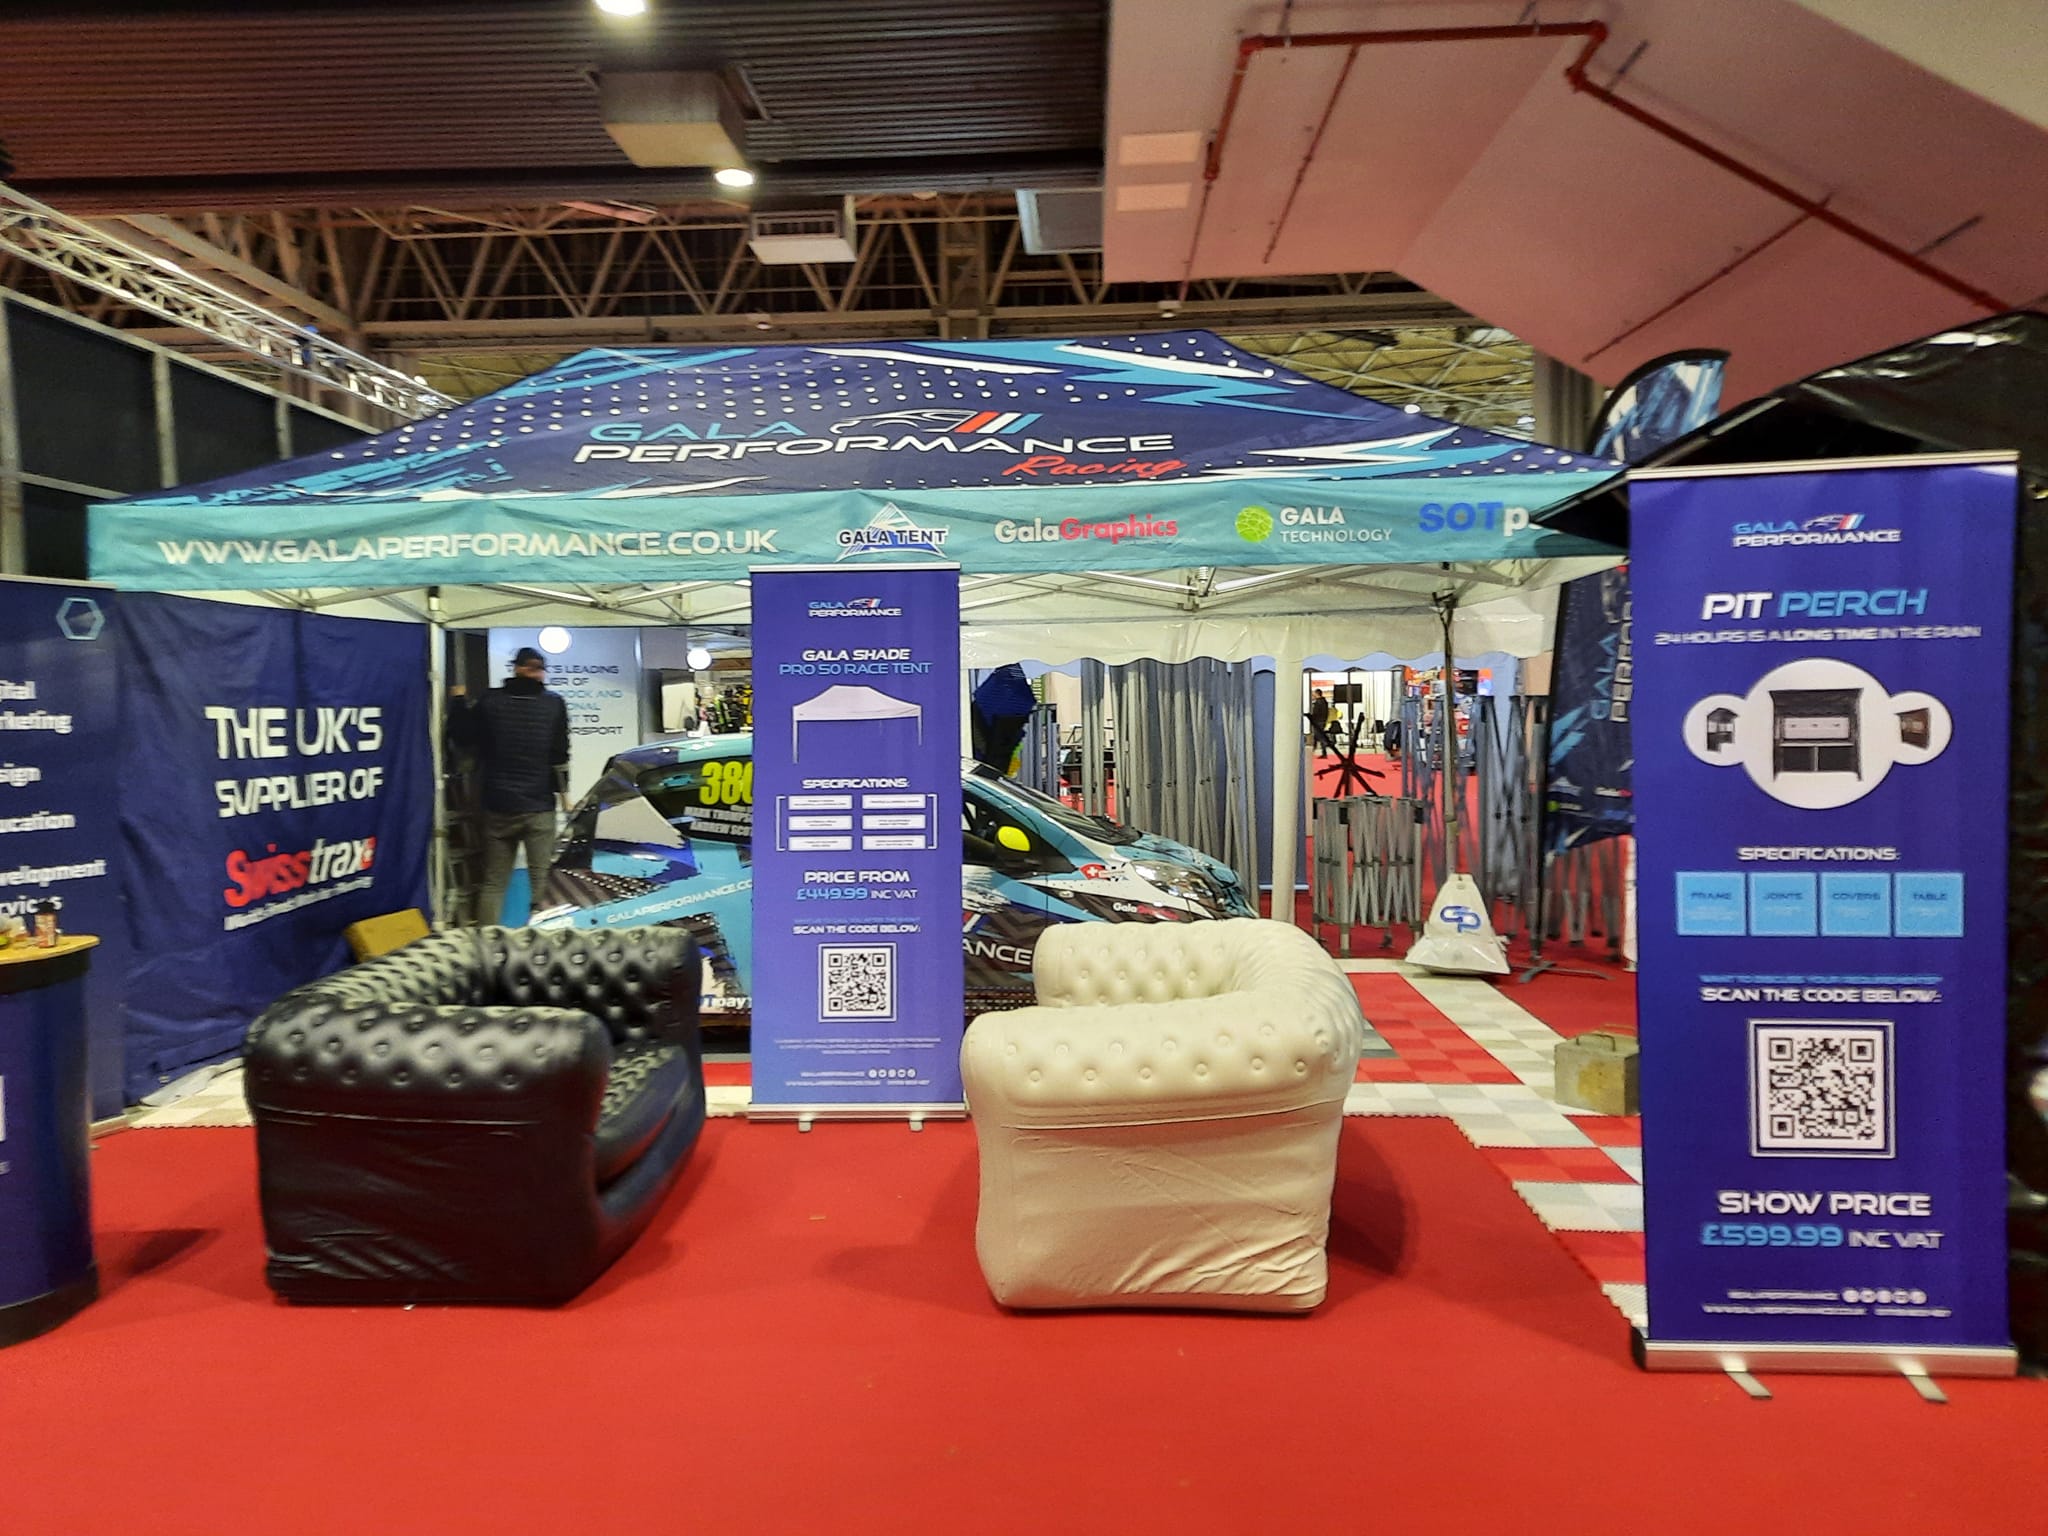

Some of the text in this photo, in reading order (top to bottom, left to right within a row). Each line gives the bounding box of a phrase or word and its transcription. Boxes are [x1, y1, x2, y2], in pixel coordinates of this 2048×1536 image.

[590, 421, 807, 442] GALA
[573, 434, 1175, 464] PERFORMANCE
[1001, 456, 1188, 478] Racing
[1280, 506, 1345, 526] GALA
[1418, 502, 1530, 537] SOTp
[995, 514, 1178, 545] GalaGraphics
[1280, 527, 1393, 545] TECHNOLOGY
[1733, 521, 1798, 533] GALA
[839, 528, 947, 546] GALA TENT
[1733, 529, 1902, 548] PERFORMANCE
[157, 528, 779, 565] WWW.GALAPERFORMANCE.CO.UK
[808, 601, 846, 609] GALA
[808, 608, 903, 618] PERFORMANCE
[1701, 588, 1929, 620] PIT PERCH
[802, 648, 911, 662] GALA SHADE
[566, 664, 620, 674] LEADING
[779, 663, 816, 676] PRO
[845, 663, 888, 675] RACE
[890, 662, 933, 674] TENT
[0, 680, 37, 700] ital
[573, 677, 590, 686] OF
[582, 714, 600, 723] TO
[205, 706, 383, 760] THE UK'S
[216, 766, 384, 818] SUPPLIER OF
[730, 825, 753, 837] SCO
[804, 870, 911, 884] PRICE FROM
[796, 887, 918, 900] £449.99 INC VAT
[0, 895, 63, 916] rvics
[793, 925, 825, 935] SCAN
[827, 925, 847, 934] THE
[848, 924, 878, 934] CODE
[1701, 987, 1761, 1002] SCAN
[1764, 987, 1801, 1002] THE
[1803, 988, 1860, 1003] CODE
[1718, 1190, 1932, 1217] SHOW PRICE
[1701, 1223, 1945, 1250] £599.99 INC VAT
